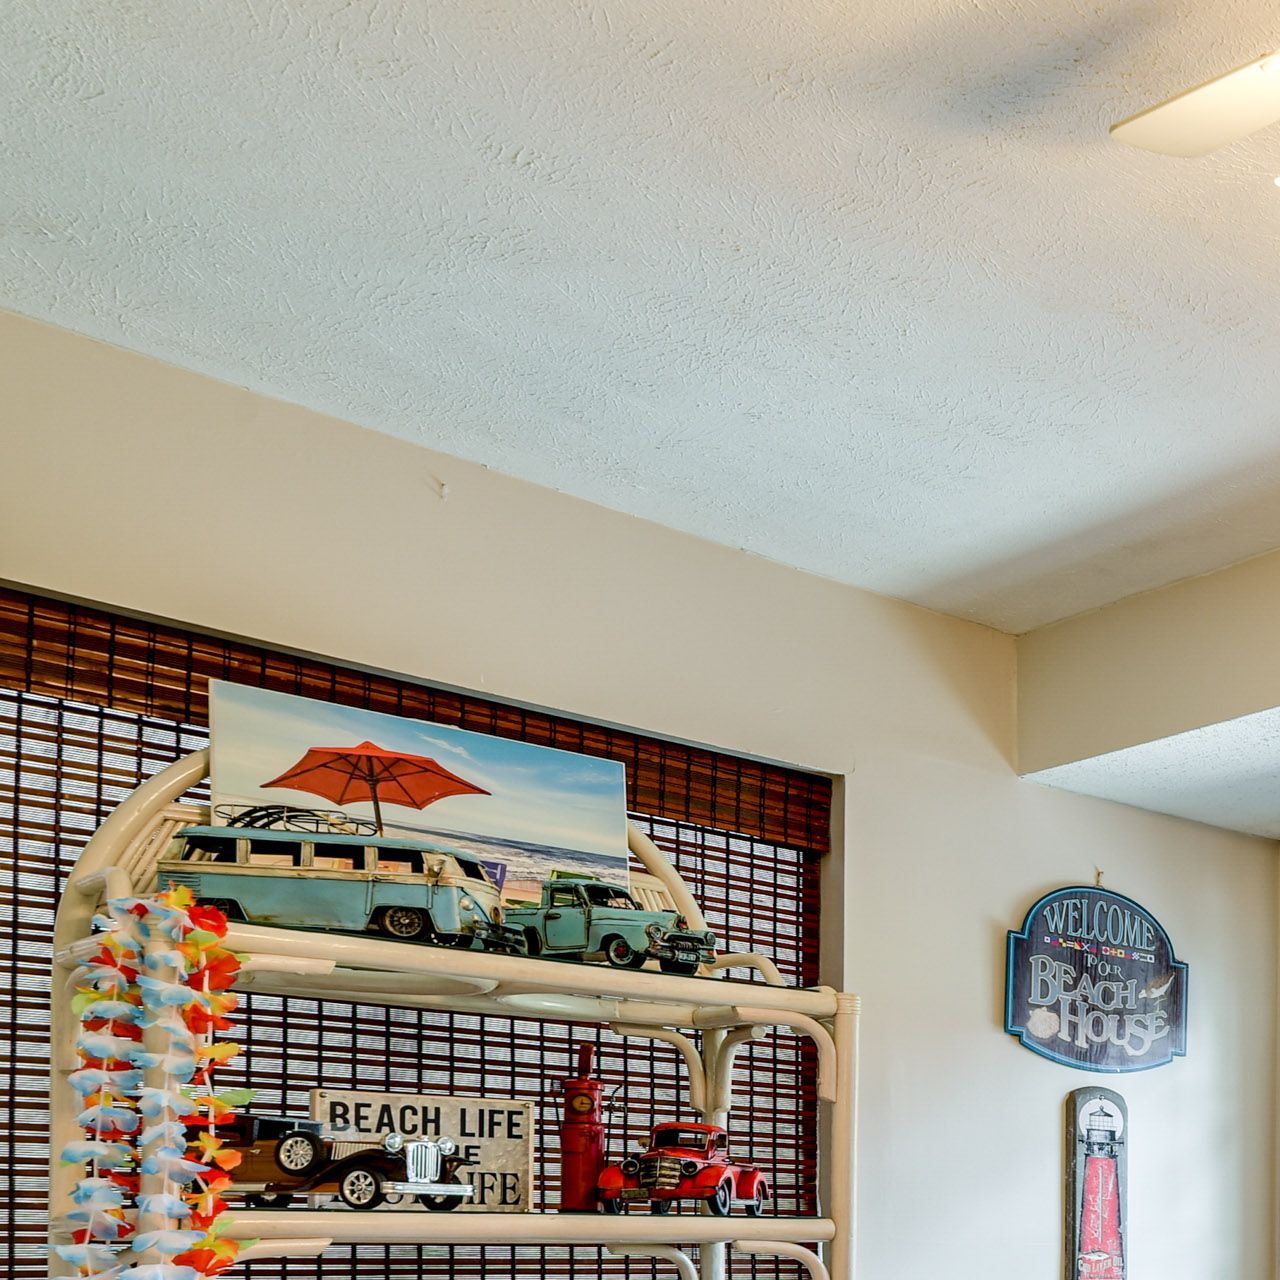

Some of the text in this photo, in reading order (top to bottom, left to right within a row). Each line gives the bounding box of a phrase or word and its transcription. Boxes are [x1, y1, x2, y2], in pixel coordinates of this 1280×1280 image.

[1043, 899, 1156, 951] WELCOME
[1028, 955, 1138, 1011] BEACH
[1058, 994, 1170, 1057] HOUSE
[329, 1101, 524, 1139] BEACH LIFE
